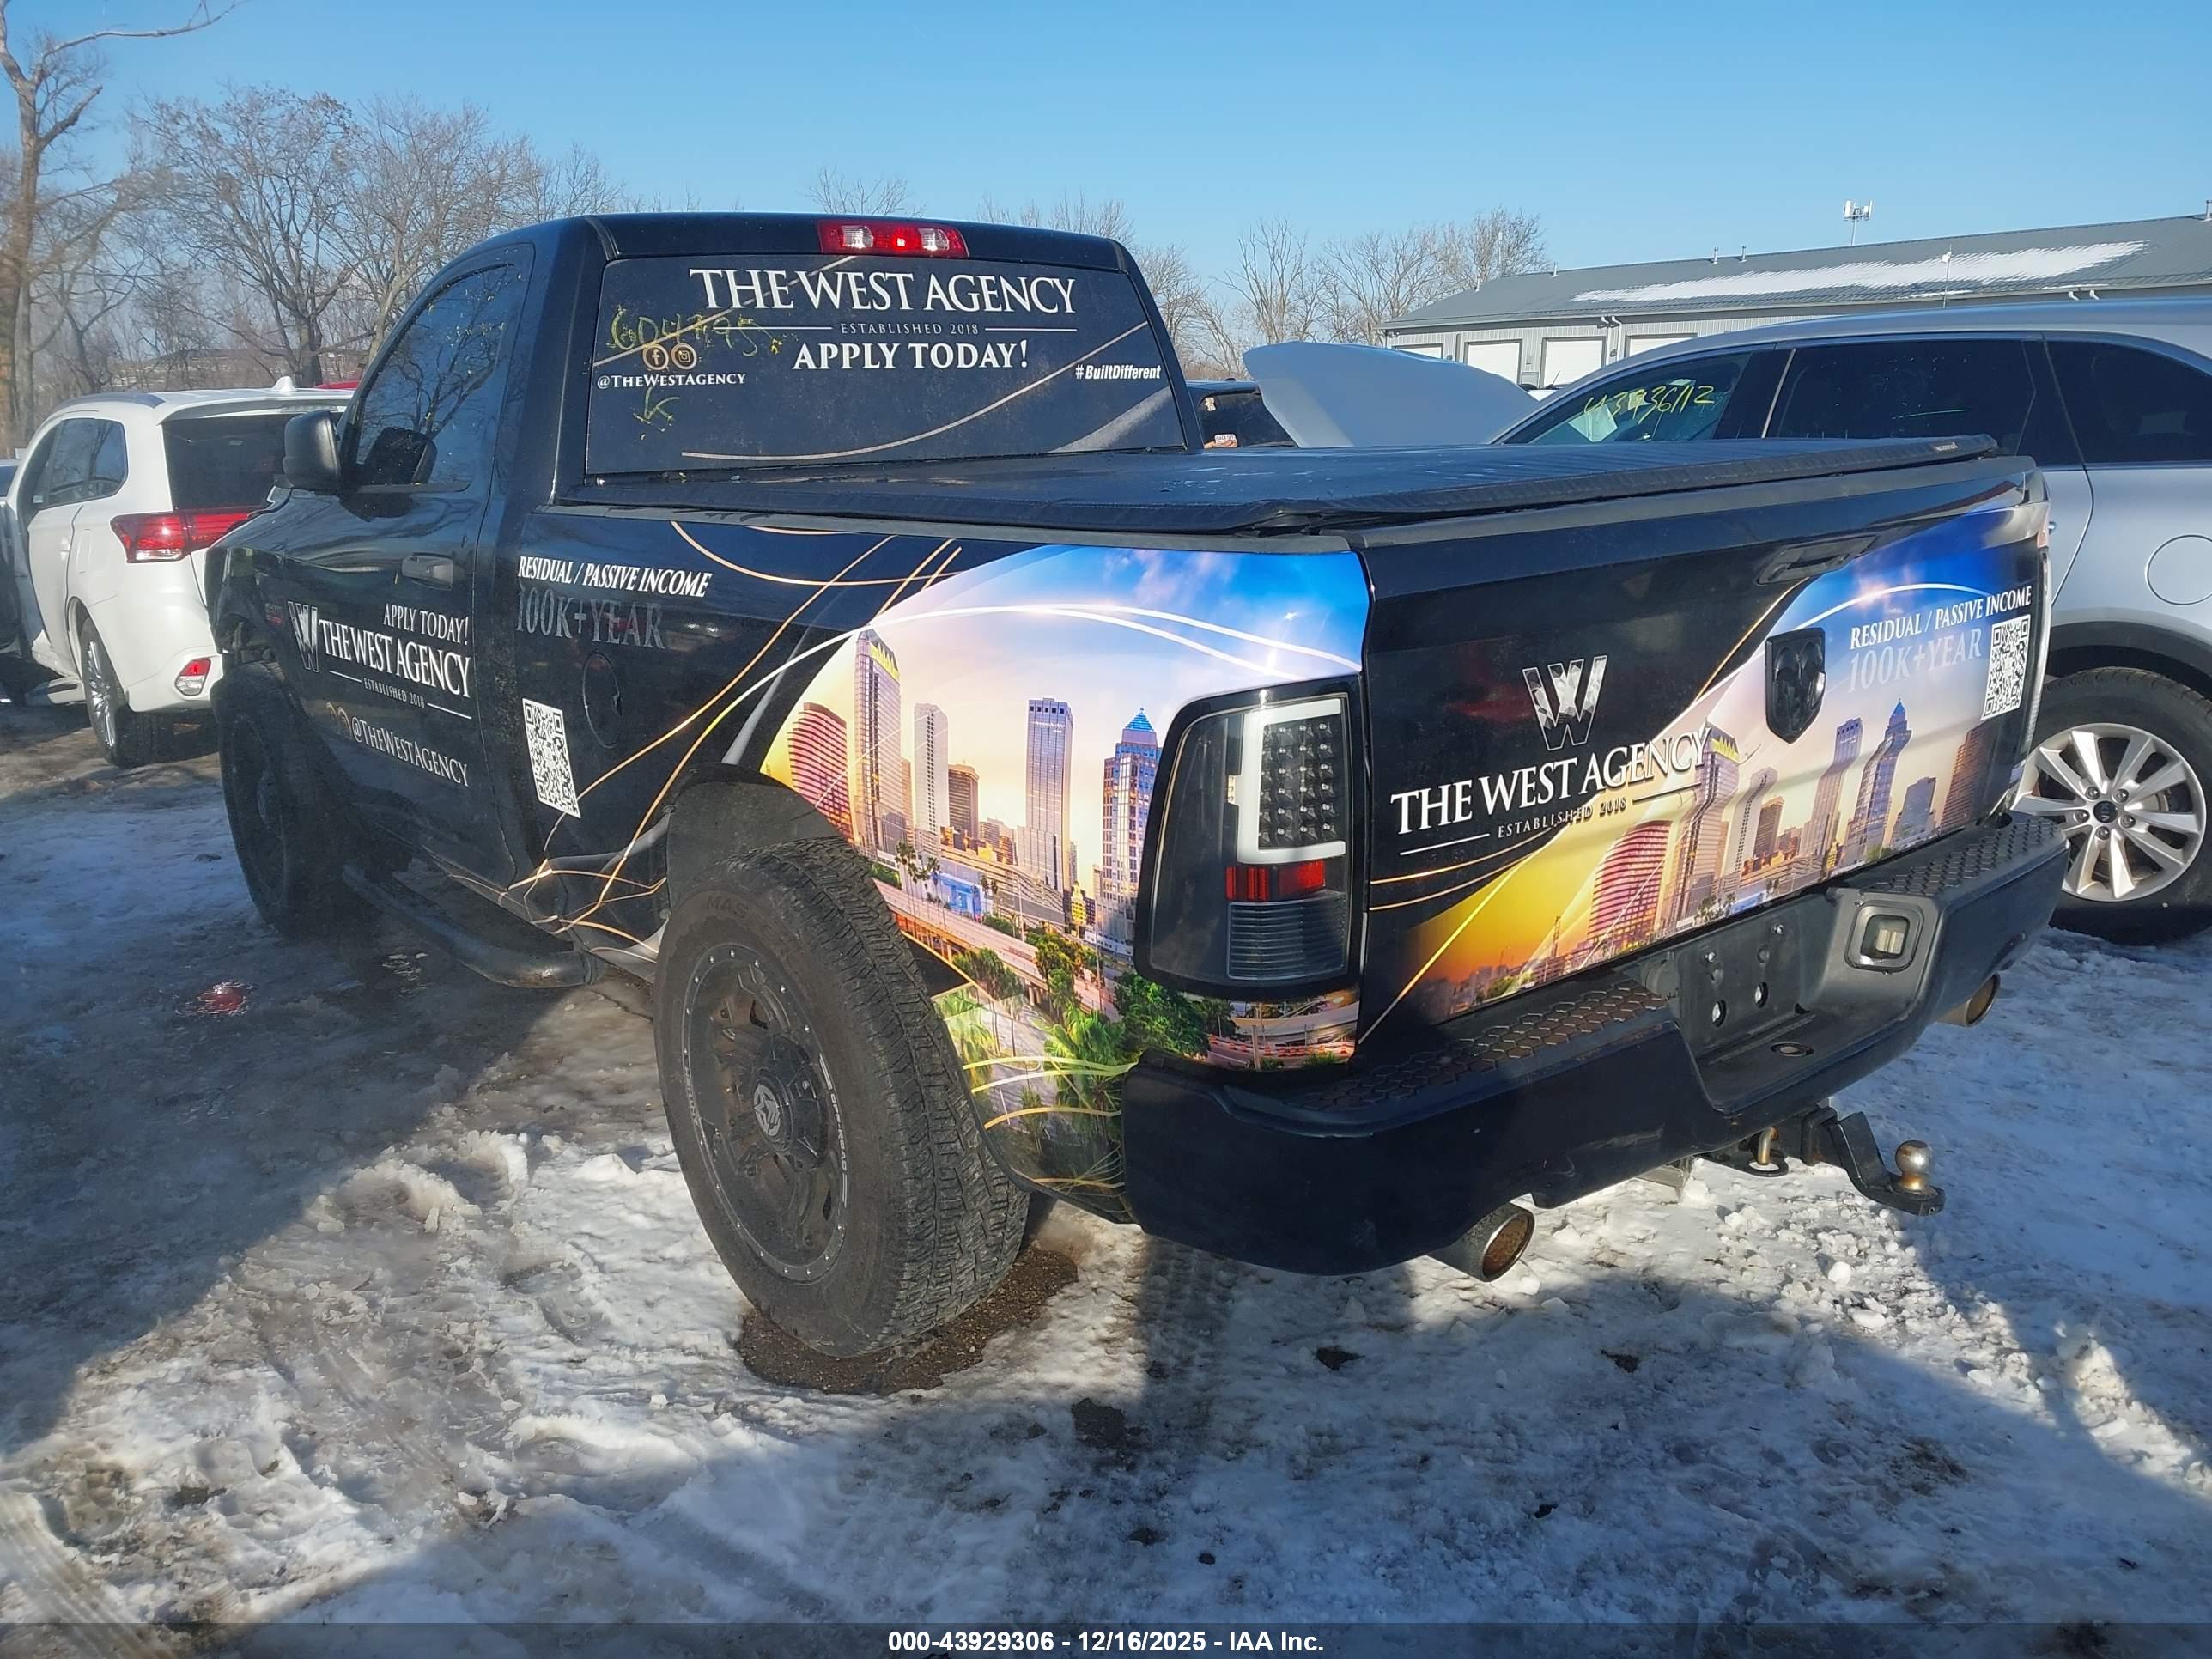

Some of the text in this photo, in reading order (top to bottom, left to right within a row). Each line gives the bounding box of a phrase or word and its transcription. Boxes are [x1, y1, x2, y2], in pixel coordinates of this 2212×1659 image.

[690, 269, 1076, 313] THE WEST AGENCY
[840, 323, 980, 335] ESTABLISHED 2018
[792, 339, 1028, 370] APPLY TODAY!
[1075, 363, 1161, 380] #BuiltDifferent
[517, 556, 574, 585] RESIDUAL
[582, 563, 641, 591] PASSIVE
[637, 568, 713, 598] INCOME
[383, 603, 469, 646] APPLY TODAY!
[1850, 613, 1923, 650] RESIDUAL
[1935, 599, 1984, 630] PASSIVE
[1985, 586, 2032, 617] INCOME
[319, 619, 471, 698] THE WEST AGENCY
[363, 678, 426, 708] ESTABLISHED 2018
[1390, 722, 1712, 836] THE WEST AGENCY
[1498, 805, 1595, 839] ESTABLISHED
